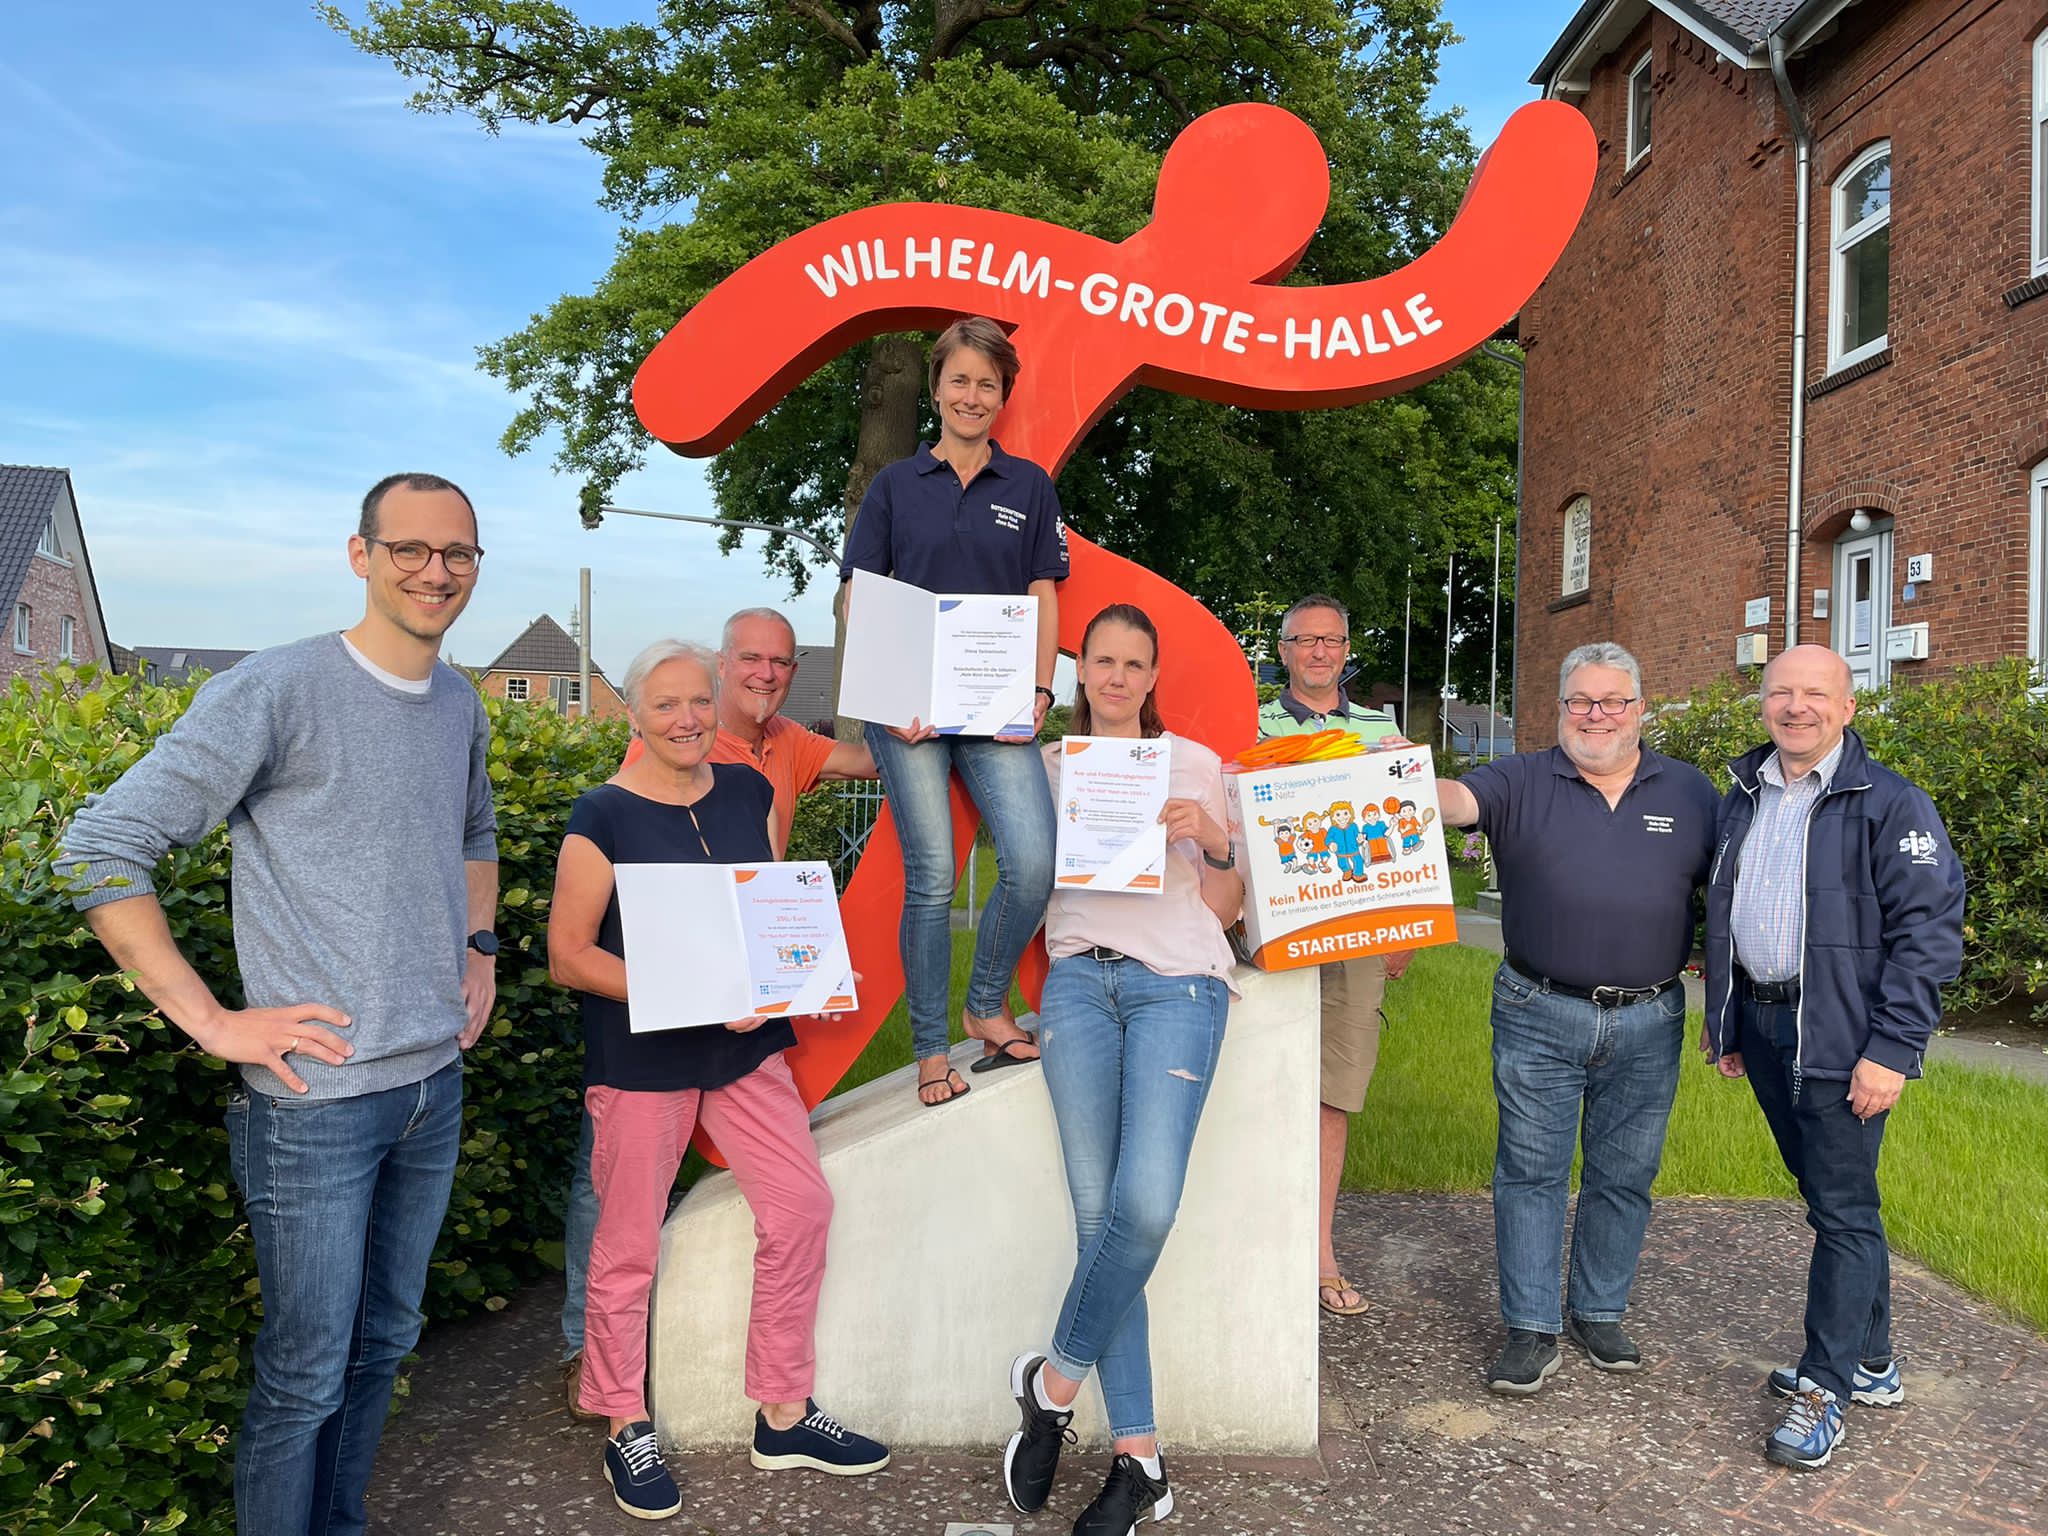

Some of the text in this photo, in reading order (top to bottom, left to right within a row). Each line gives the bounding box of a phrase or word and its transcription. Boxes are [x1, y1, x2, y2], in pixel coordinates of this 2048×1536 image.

[804, 237, 1443, 359] WILHELM-GROTE-HALLE
[1910, 561, 1921, 577] 53
[1269, 863, 1438, 907] Kein Kind ohne Sport!
[1288, 904, 1318, 916] Initiative
[1320, 901, 1332, 910] der
[1333, 896, 1376, 909] Sportjugend
[1287, 920, 1434, 958] STARTER-PAKET
